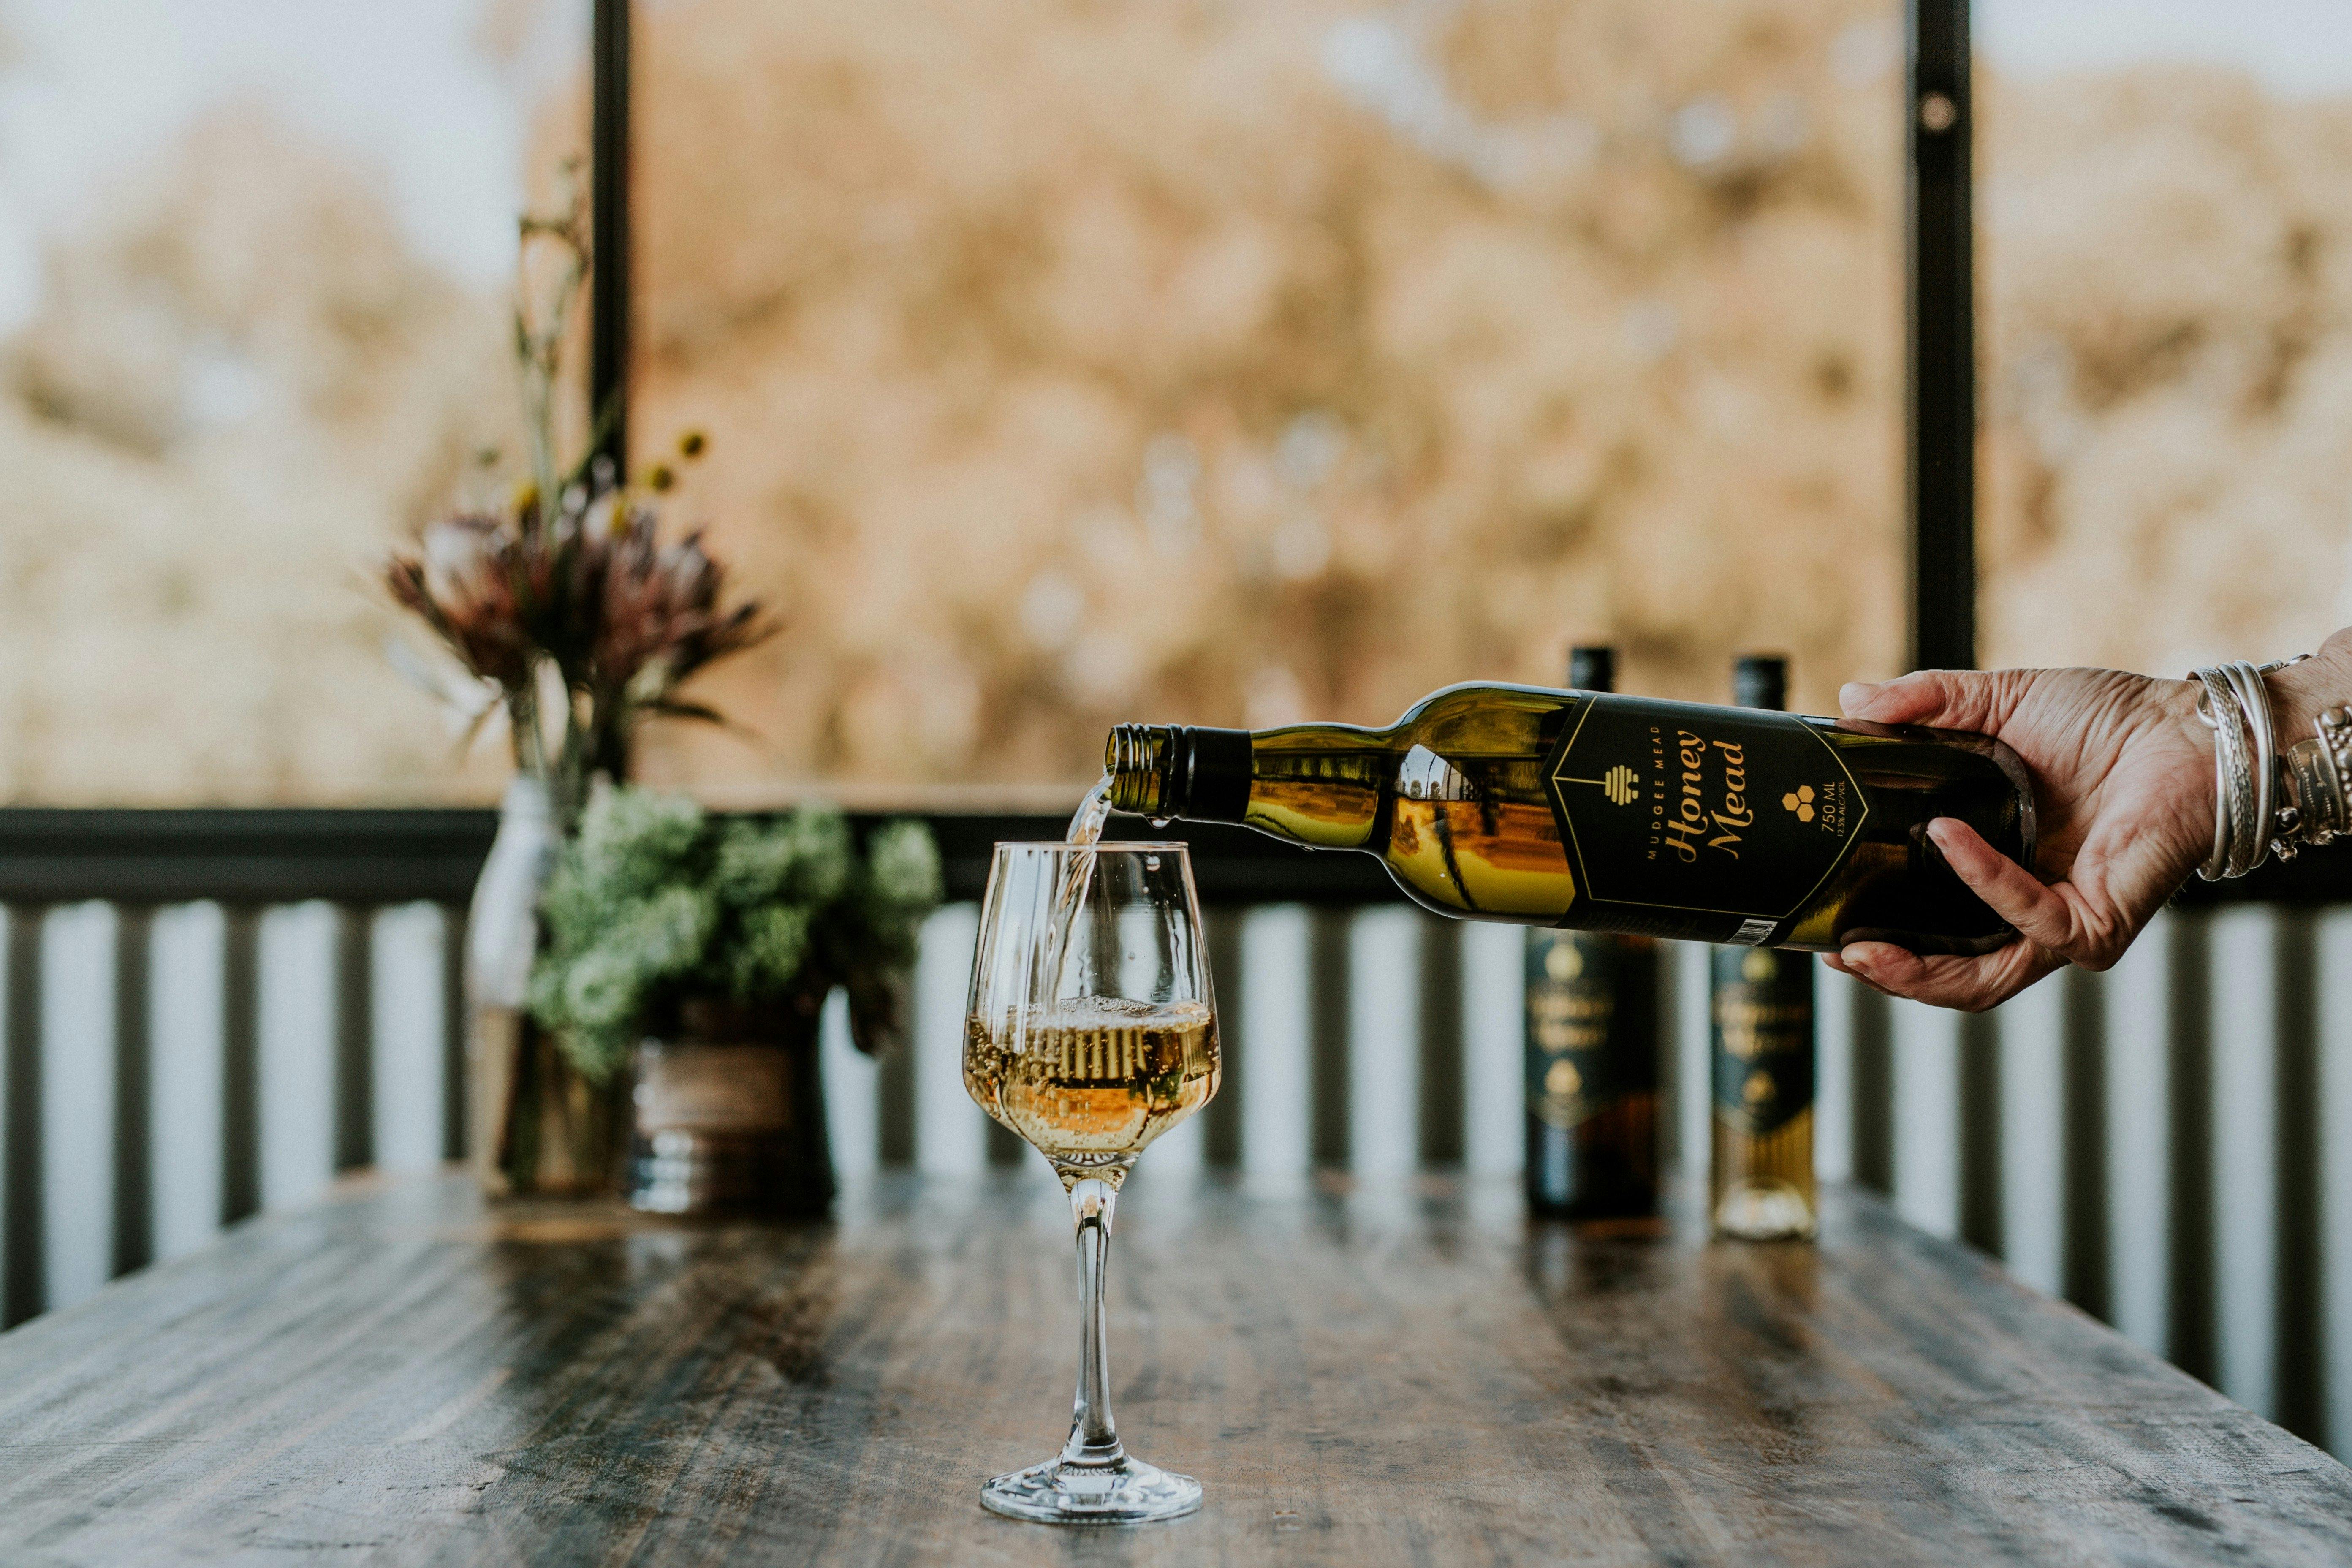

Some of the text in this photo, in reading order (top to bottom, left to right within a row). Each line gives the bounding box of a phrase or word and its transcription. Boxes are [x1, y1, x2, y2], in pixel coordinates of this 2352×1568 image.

[1647, 727, 1665, 860] MUDGEE MEAD
[1665, 730, 1708, 862] Honey
[1708, 740, 1753, 859] Mead
[1822, 782, 1836, 832] 750 ML
[1837, 817, 1845, 837] 12.5%
